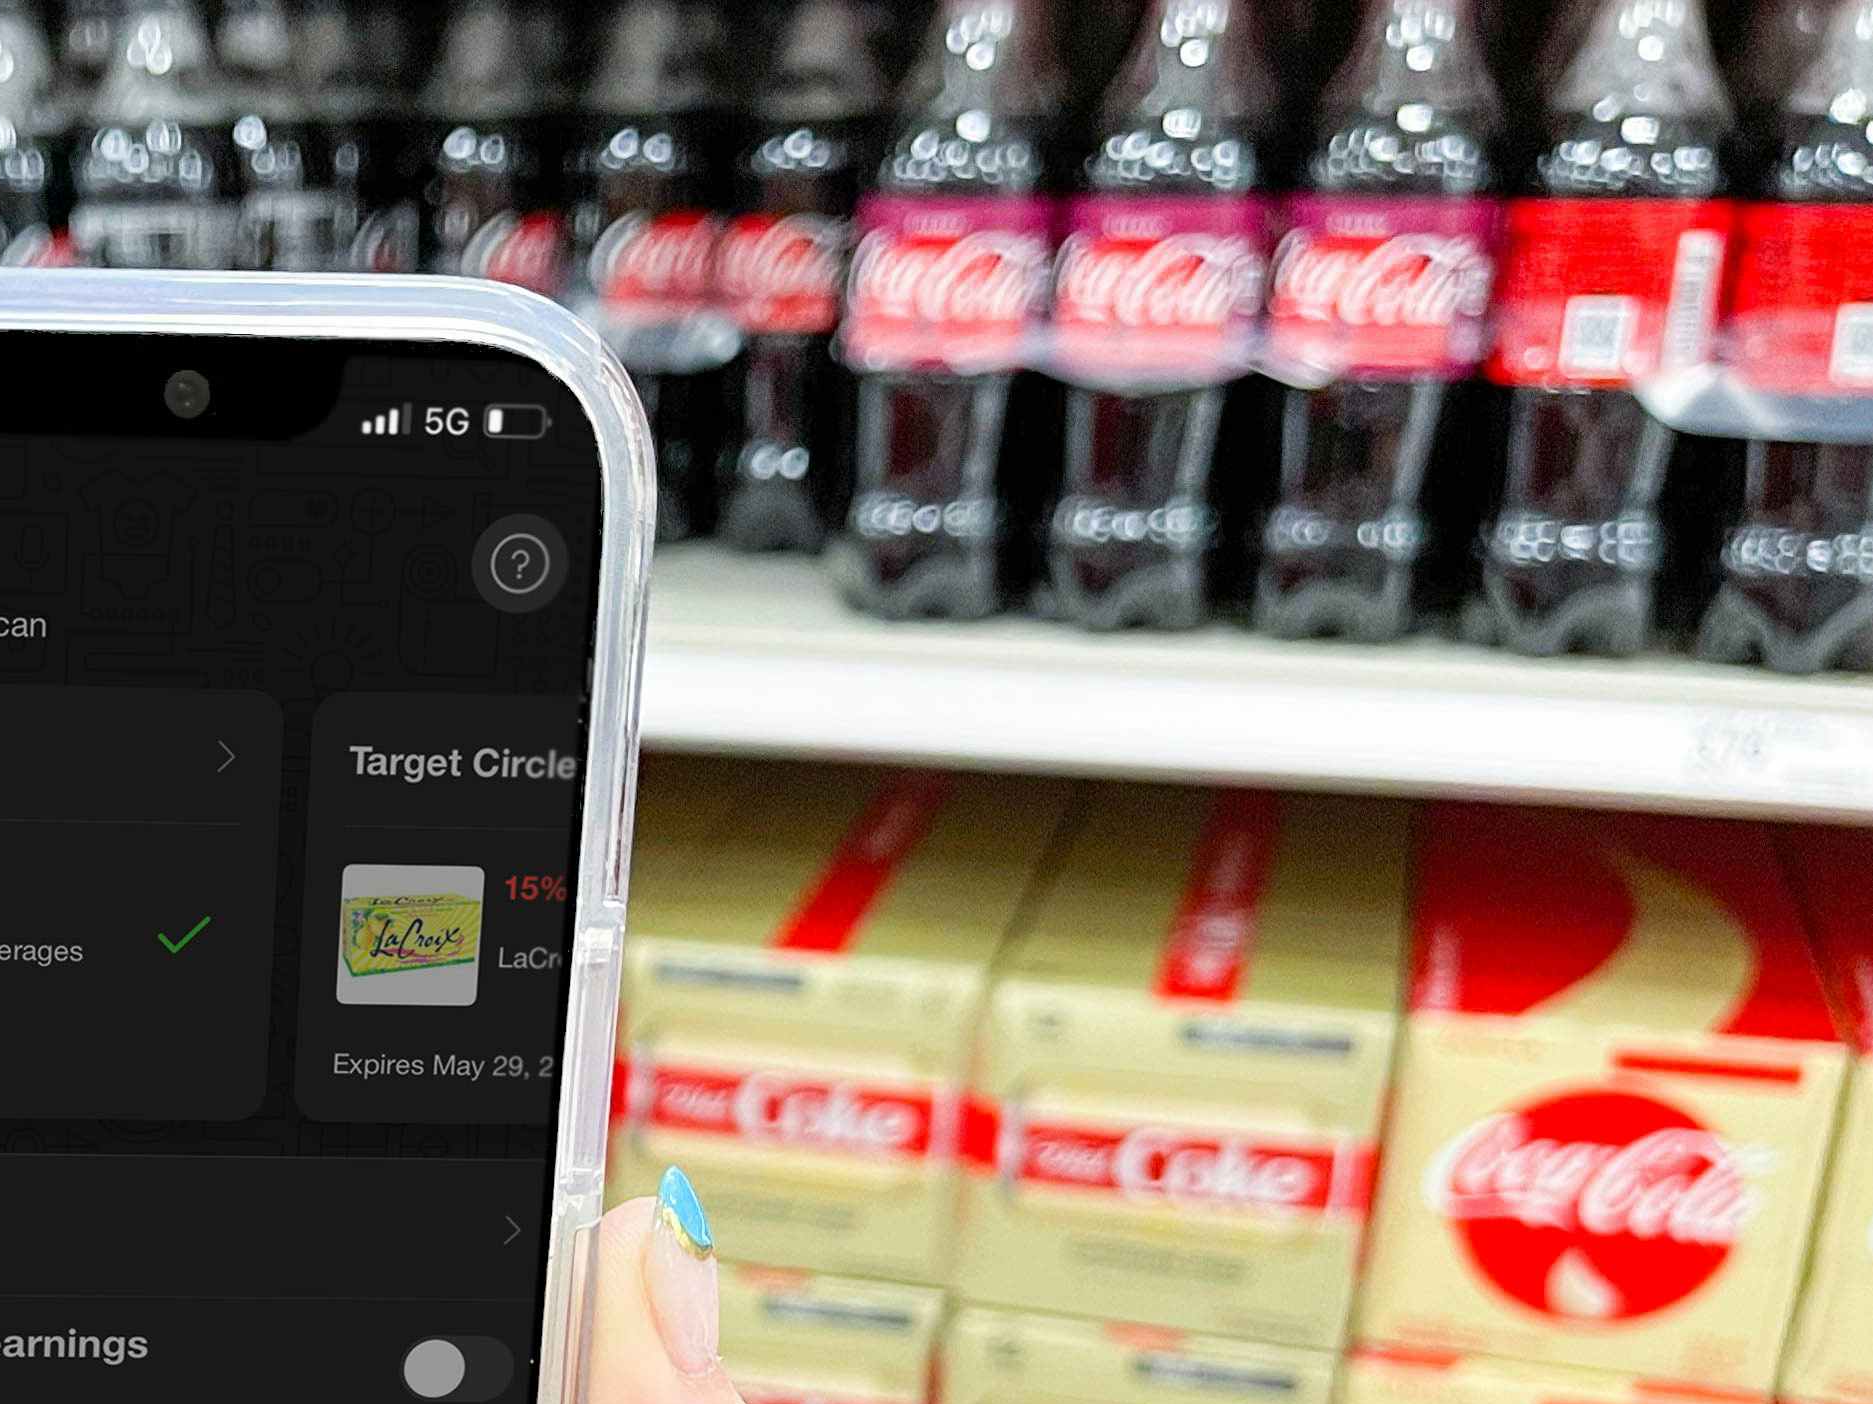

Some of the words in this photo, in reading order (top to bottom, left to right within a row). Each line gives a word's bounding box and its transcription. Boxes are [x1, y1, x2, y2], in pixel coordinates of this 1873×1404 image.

[425, 408, 469, 435] 5G
[350, 746, 462, 783] Target
[474, 748, 575, 779] Circle
[505, 877, 567, 900] 15%
[334, 1053, 424, 1079] Expires
[433, 1055, 485, 1081] May
[493, 1056, 529, 1079] 29,
[735, 1068, 918, 1148] Coke
[1114, 1125, 1318, 1206] Coke
